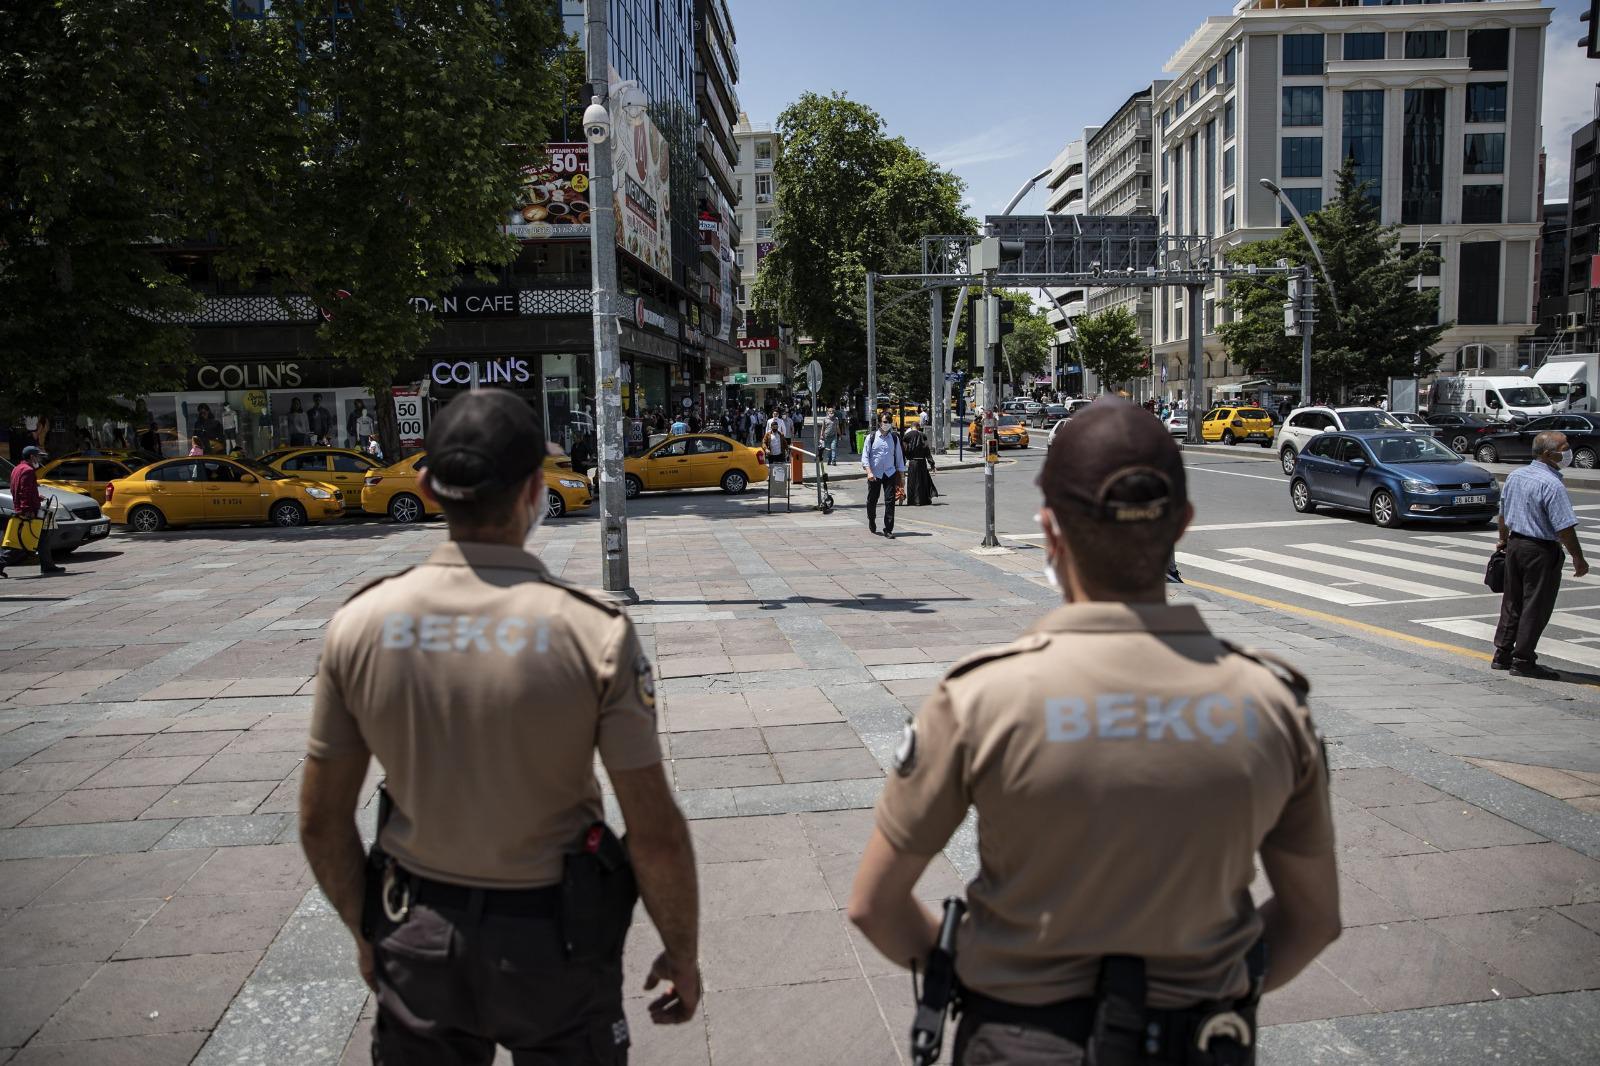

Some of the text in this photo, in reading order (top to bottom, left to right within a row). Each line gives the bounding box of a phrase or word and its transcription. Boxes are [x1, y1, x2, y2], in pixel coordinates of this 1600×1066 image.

[552, 153, 577, 173] 50
[579, 163, 589, 172] TL
[577, 175, 582, 183] 2
[465, 295, 514, 312] CAFE
[736, 339, 770, 348] LARI
[197, 362, 302, 389] COLIN'S
[432, 356, 530, 385] COIN'S
[398, 403, 417, 416] 50
[398, 421, 421, 435] 100
